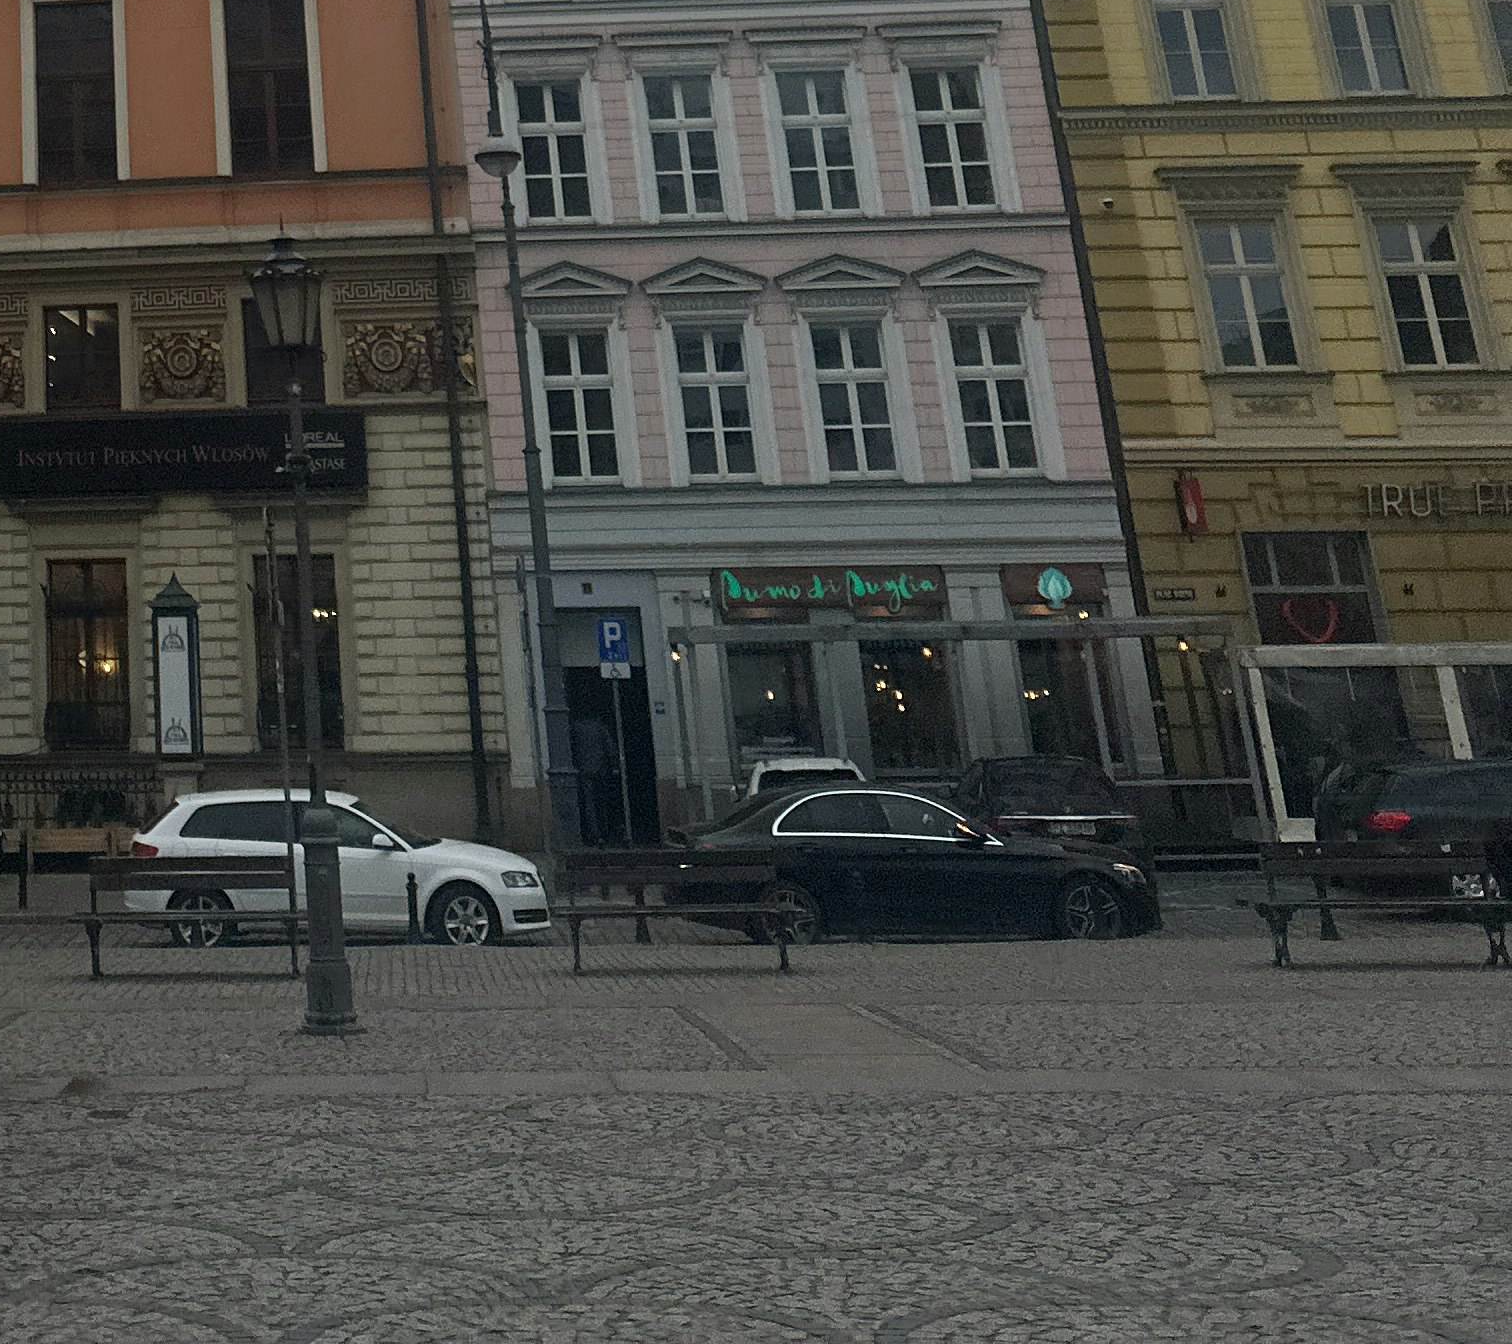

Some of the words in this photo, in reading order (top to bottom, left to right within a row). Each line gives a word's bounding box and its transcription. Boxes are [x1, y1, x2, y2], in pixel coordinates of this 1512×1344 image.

[808, 574, 838, 599] di
[846, 569, 937, 613] Puglia
[603, 621, 622, 648] P
